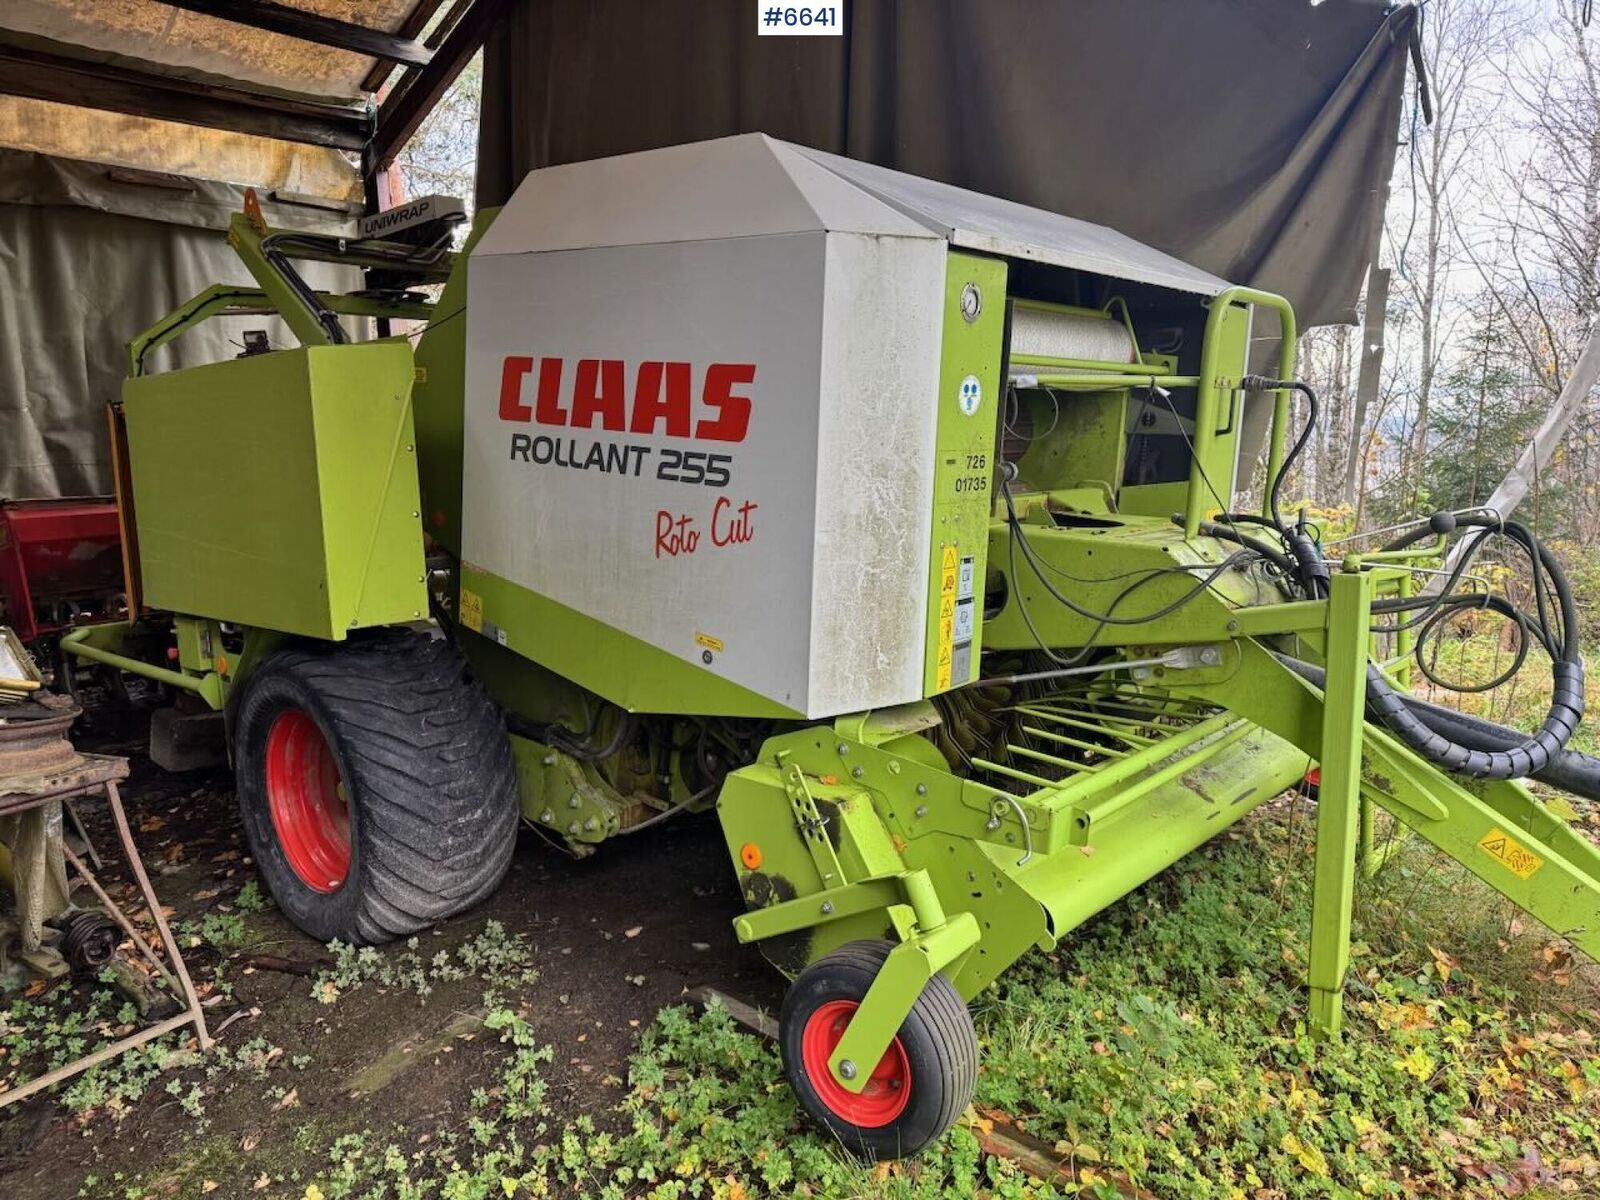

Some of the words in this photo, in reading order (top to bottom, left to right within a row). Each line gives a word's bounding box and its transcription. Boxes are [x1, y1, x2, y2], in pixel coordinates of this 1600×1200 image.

[365, 202, 430, 234] UNIWRAP
[499, 356, 756, 443] CLAAS
[510, 433, 651, 477] ROLLANT
[656, 449, 732, 487] 255
[966, 454, 986, 470] 726
[955, 476, 987, 492] 01735
[655, 510, 700, 559] Roto
[711, 496, 758, 547] Cut
